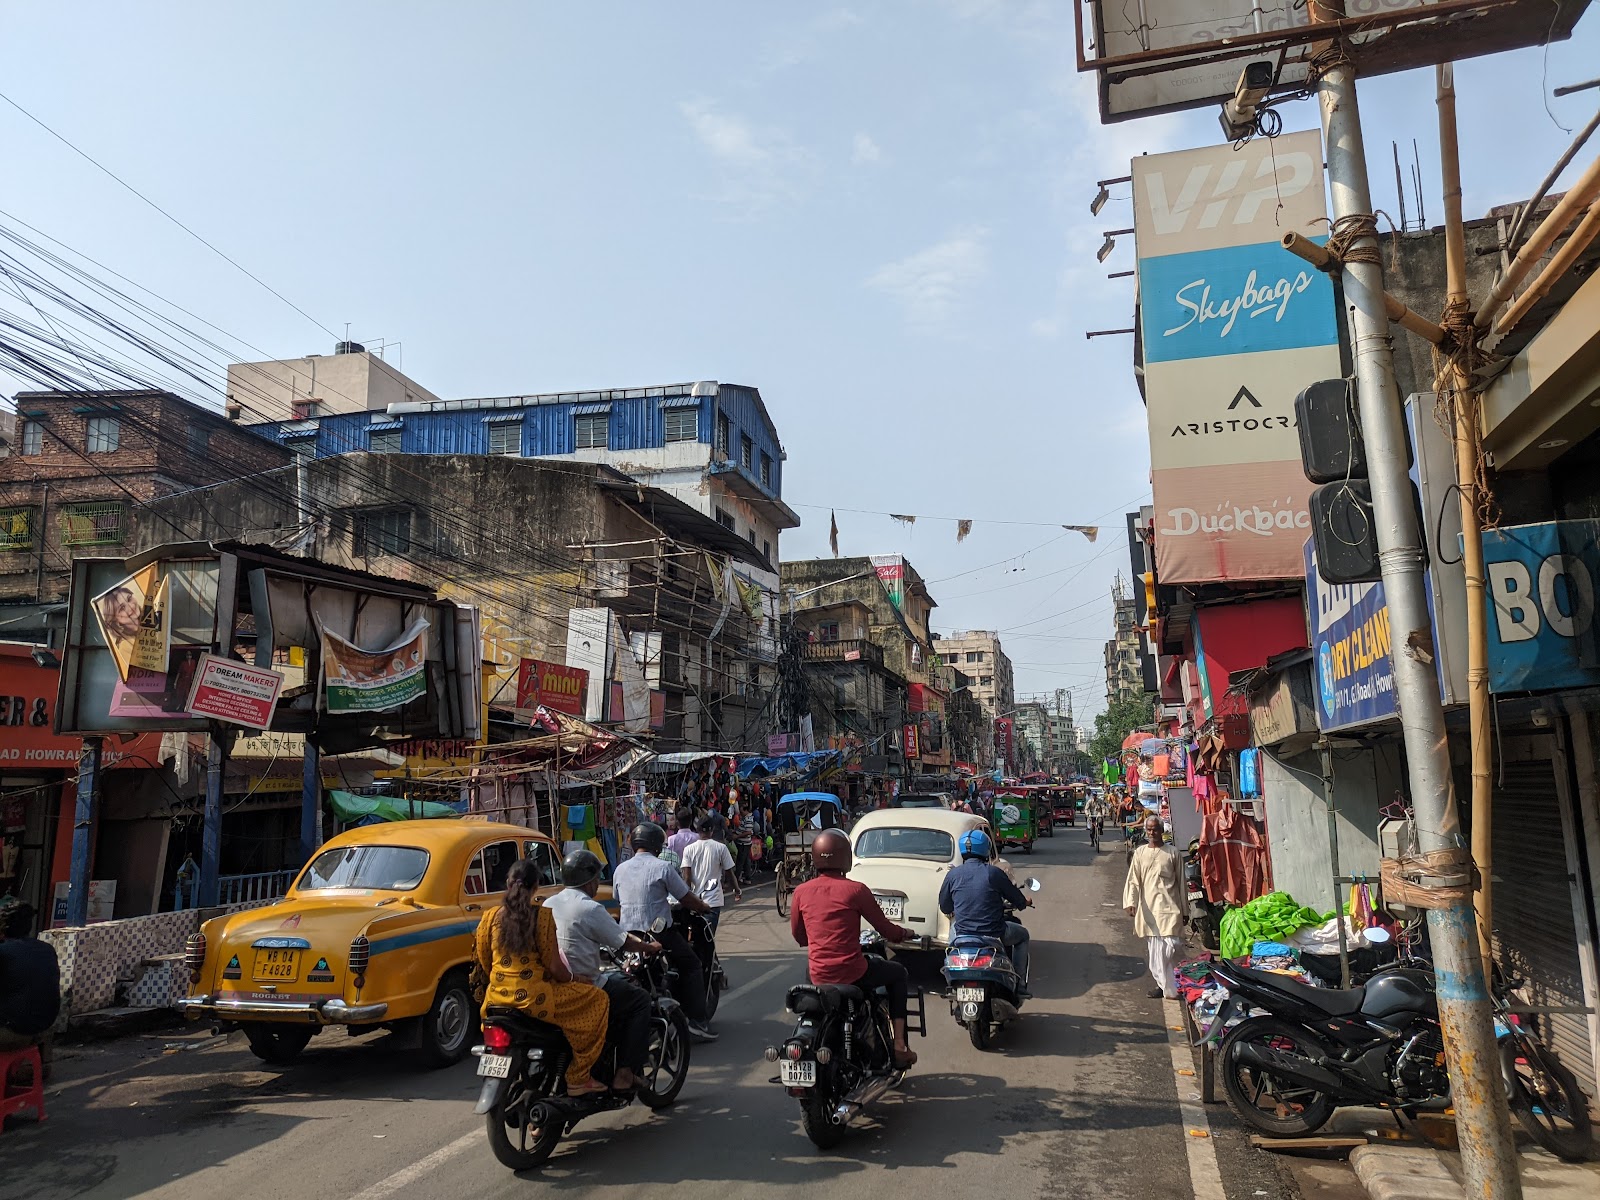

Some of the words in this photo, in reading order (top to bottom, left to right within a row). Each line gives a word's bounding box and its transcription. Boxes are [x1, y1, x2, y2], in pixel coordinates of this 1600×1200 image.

[1144, 151, 1314, 236] VIP
[1163, 270, 1314, 337] Skybags
[876, 566, 898, 578] Sale
[1331, 636, 1351, 682] DRY
[127, 669, 155, 679] NDIA
[216, 667, 243, 679] DREAM
[243, 674, 275, 687] MAKERS
[542, 672, 581, 695] MINU
[208, 694, 230, 703] INTERIOR
[217, 691, 232, 699] HOME
[236, 696, 253, 704] OFFICE
[29, 697, 49, 727] &
[194, 702, 218, 712] MODULAR
[218, 708, 239, 717] KITCHEN
[201, 698, 225, 709] DESIGNER
[224, 704, 240, 712] FALSE
[240, 707, 257, 716] CEILING
[268, 951, 278, 962] WB
[282, 951, 294, 963] 04
[262, 964, 293, 976] F4828
[487, 1066, 507, 1077] 8567
